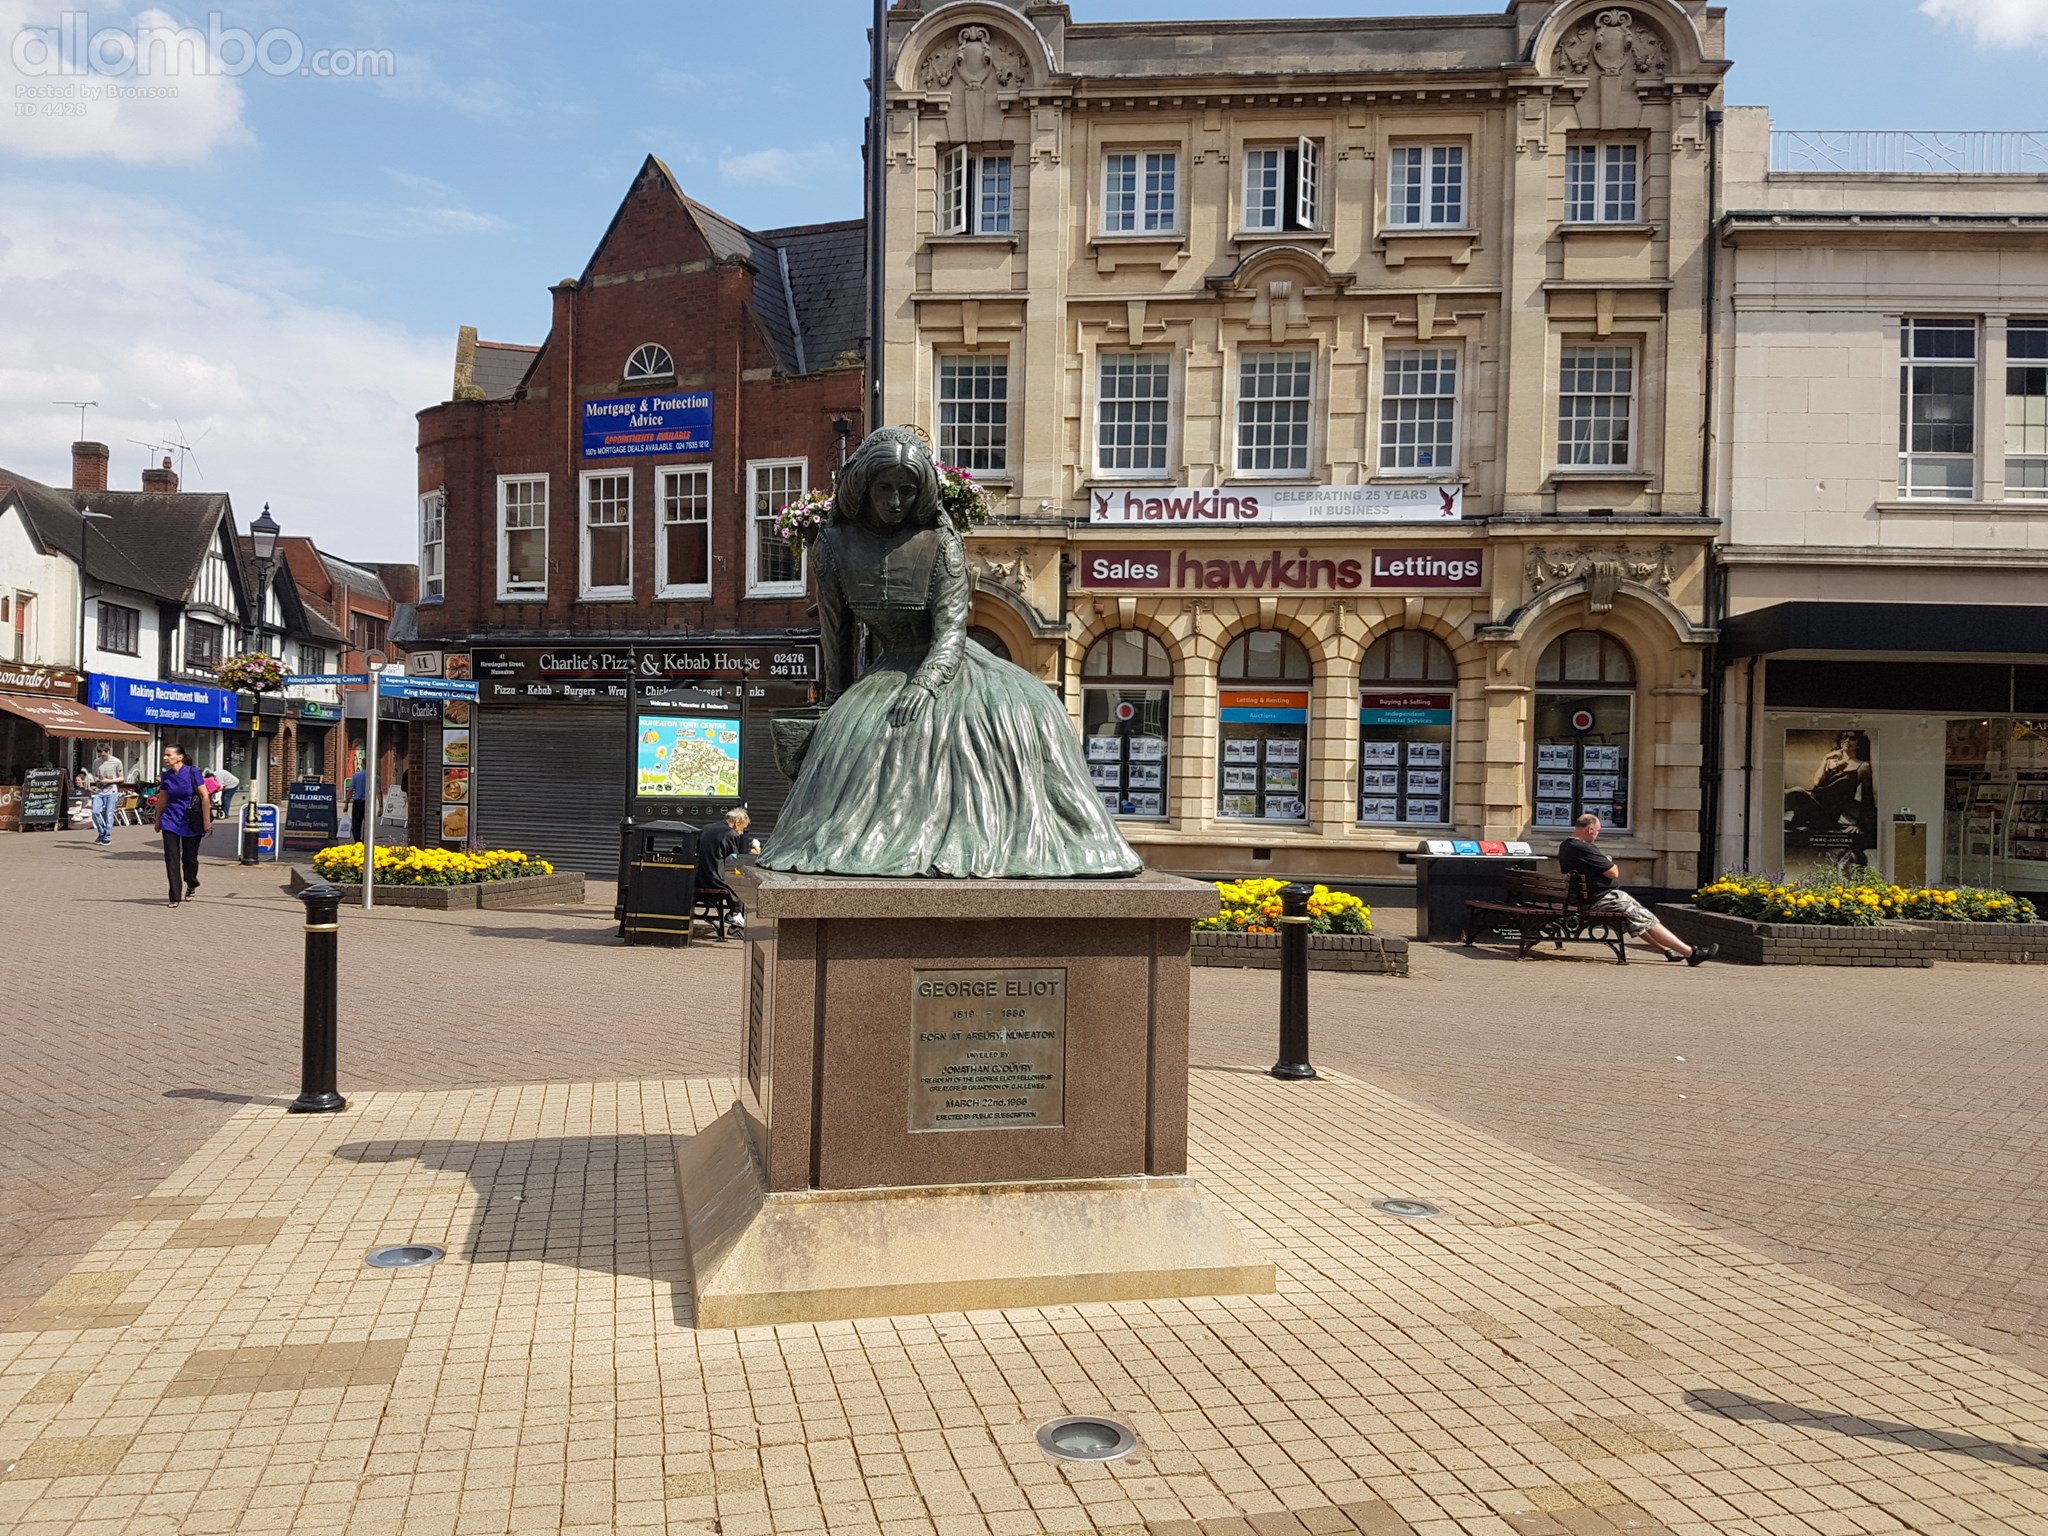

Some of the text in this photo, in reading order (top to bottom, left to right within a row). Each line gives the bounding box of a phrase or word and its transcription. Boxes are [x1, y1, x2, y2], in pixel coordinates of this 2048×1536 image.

[586, 395, 709, 417] Mortgage & Protection
[629, 414, 663, 427] Advice
[605, 431, 691, 445] APPOINTMENTS AVAILABLE
[585, 448, 597, 456] 100's
[597, 446, 627, 455] MORTGAGE
[628, 444, 644, 453] DEALS
[645, 443, 673, 452] AVAILABLE
[676, 442, 685, 450] 024
[699, 440, 710, 448] 1212
[1274, 490, 1428, 501] CELEBRATING 25 YEARS
[1124, 489, 1259, 520] hawkins
[1309, 505, 1390, 516] IN BUSINESS
[1092, 558, 1159, 580] Sales
[1177, 547, 1363, 589] hawkins
[1374, 556, 1479, 582] Lettings
[417, 656, 430, 669] 11
[773, 653, 805, 663] 02476
[539, 653, 599, 670] Charlie's
[601, 653, 637, 670] Pizz
[640, 653, 663, 676] &
[663, 653, 711, 670] Kebab
[770, 665, 808, 675] 346 111
[0, 669, 51, 689] onardo's
[287, 676, 316, 684] Abbeygate
[316, 676, 342, 684] Shopping
[410, 679, 431, 687] Shopping
[130, 683, 209, 704] Making Recruitment Work
[403, 688, 418, 697] King
[419, 689, 443, 697] Edward
[451, 691, 475, 700] College
[494, 684, 516, 695] Pizza
[527, 684, 552, 696] Kebab
[564, 685, 596, 698] Burgers
[736, 686, 765, 697] Dnks
[1265, 697, 1290, 705] Renting
[145, 706, 196, 721] Hiring Strategies Limited
[411, 703, 438, 717] Charlie's
[640, 719, 727, 730] NUNEATON TOWN CENTRE
[290, 793, 333, 802] TAILORING
[652, 854, 674, 863] Litter
[918, 980, 1059, 998] GEORGE ELIOT
[952, 1009, 975, 1019] 1819
[1002, 1009, 1026, 1018] 1880
[920, 1032, 947, 1041] BORN
[951, 1032, 962, 1040] AT
[1005, 1031, 1055, 1040] NUNEATON
[966, 1051, 999, 1059] UNVEILED
[941, 1064, 990, 1075] JONATHAN
[1002, 1063, 1033, 1073] OUVRY
[921, 1076, 953, 1084] PRESIDENT
[946, 1098, 980, 1108] MARCH
[994, 1112, 1037, 1120] SUBSCRIPTION
